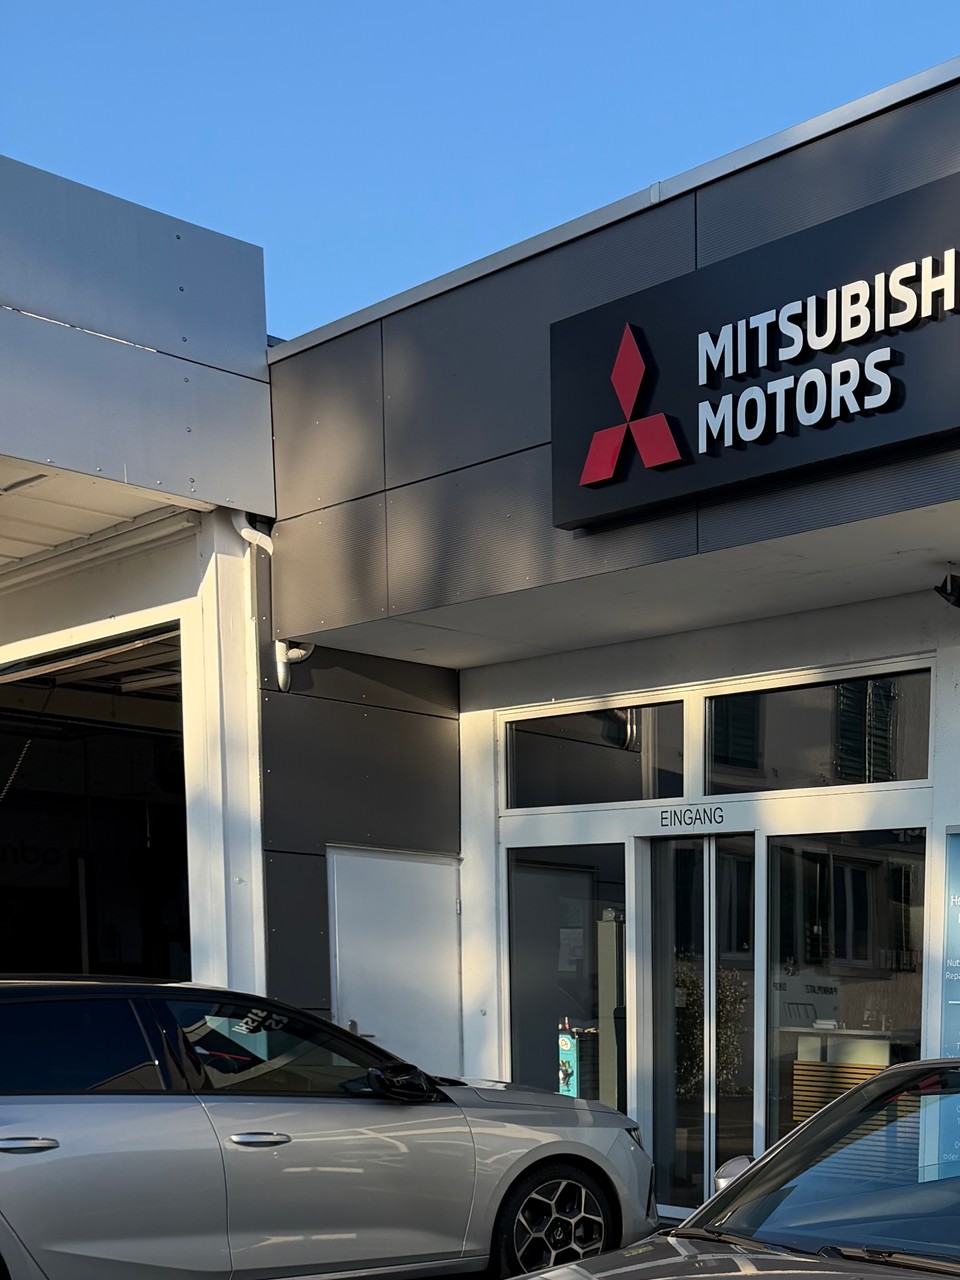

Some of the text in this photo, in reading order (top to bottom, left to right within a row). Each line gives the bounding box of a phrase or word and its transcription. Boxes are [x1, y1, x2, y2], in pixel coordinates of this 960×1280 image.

[698, 347, 893, 454] MOTORS
[660, 806, 724, 827] EINGANG
[943, 1152, 959, 1161] oder
